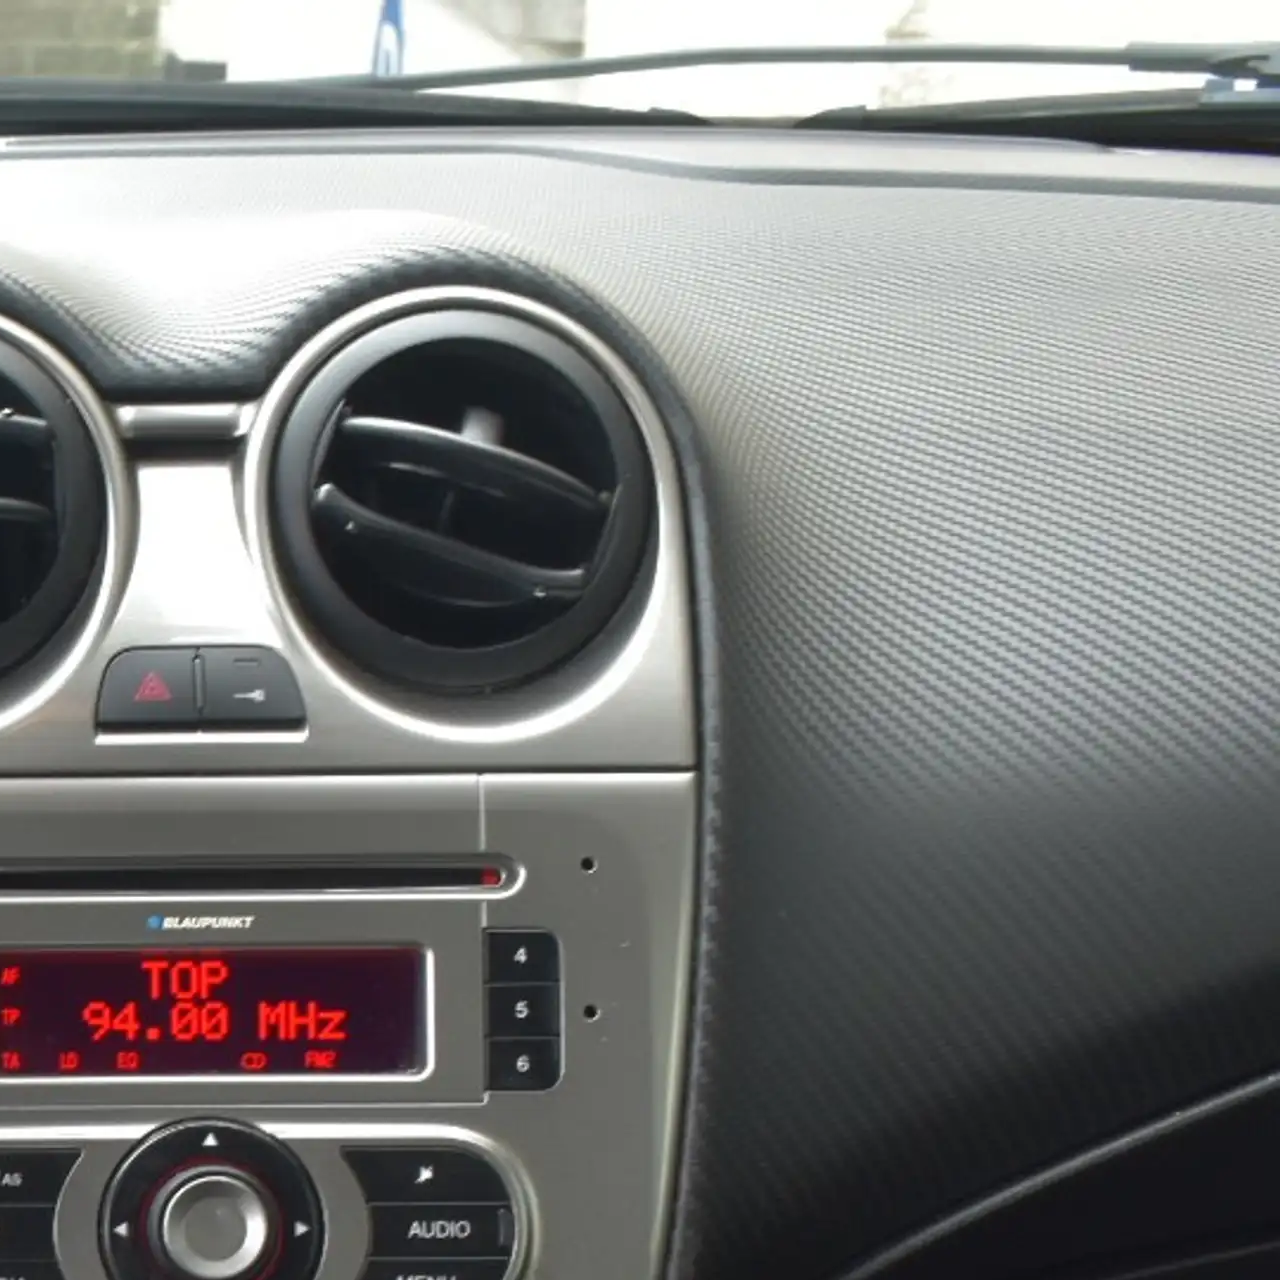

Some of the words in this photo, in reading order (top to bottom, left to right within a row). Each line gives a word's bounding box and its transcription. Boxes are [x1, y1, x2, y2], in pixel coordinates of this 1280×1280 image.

[161, 915, 256, 930] BLAUPUNKT
[513, 946, 528, 964] 4
[141, 960, 229, 1001] TOP
[514, 1000, 529, 1019] 5
[82, 1001, 230, 1041] 94.00
[257, 1001, 347, 1040] MHz
[516, 1054, 530, 1073] 6
[407, 1221, 471, 1239] AUDIO
